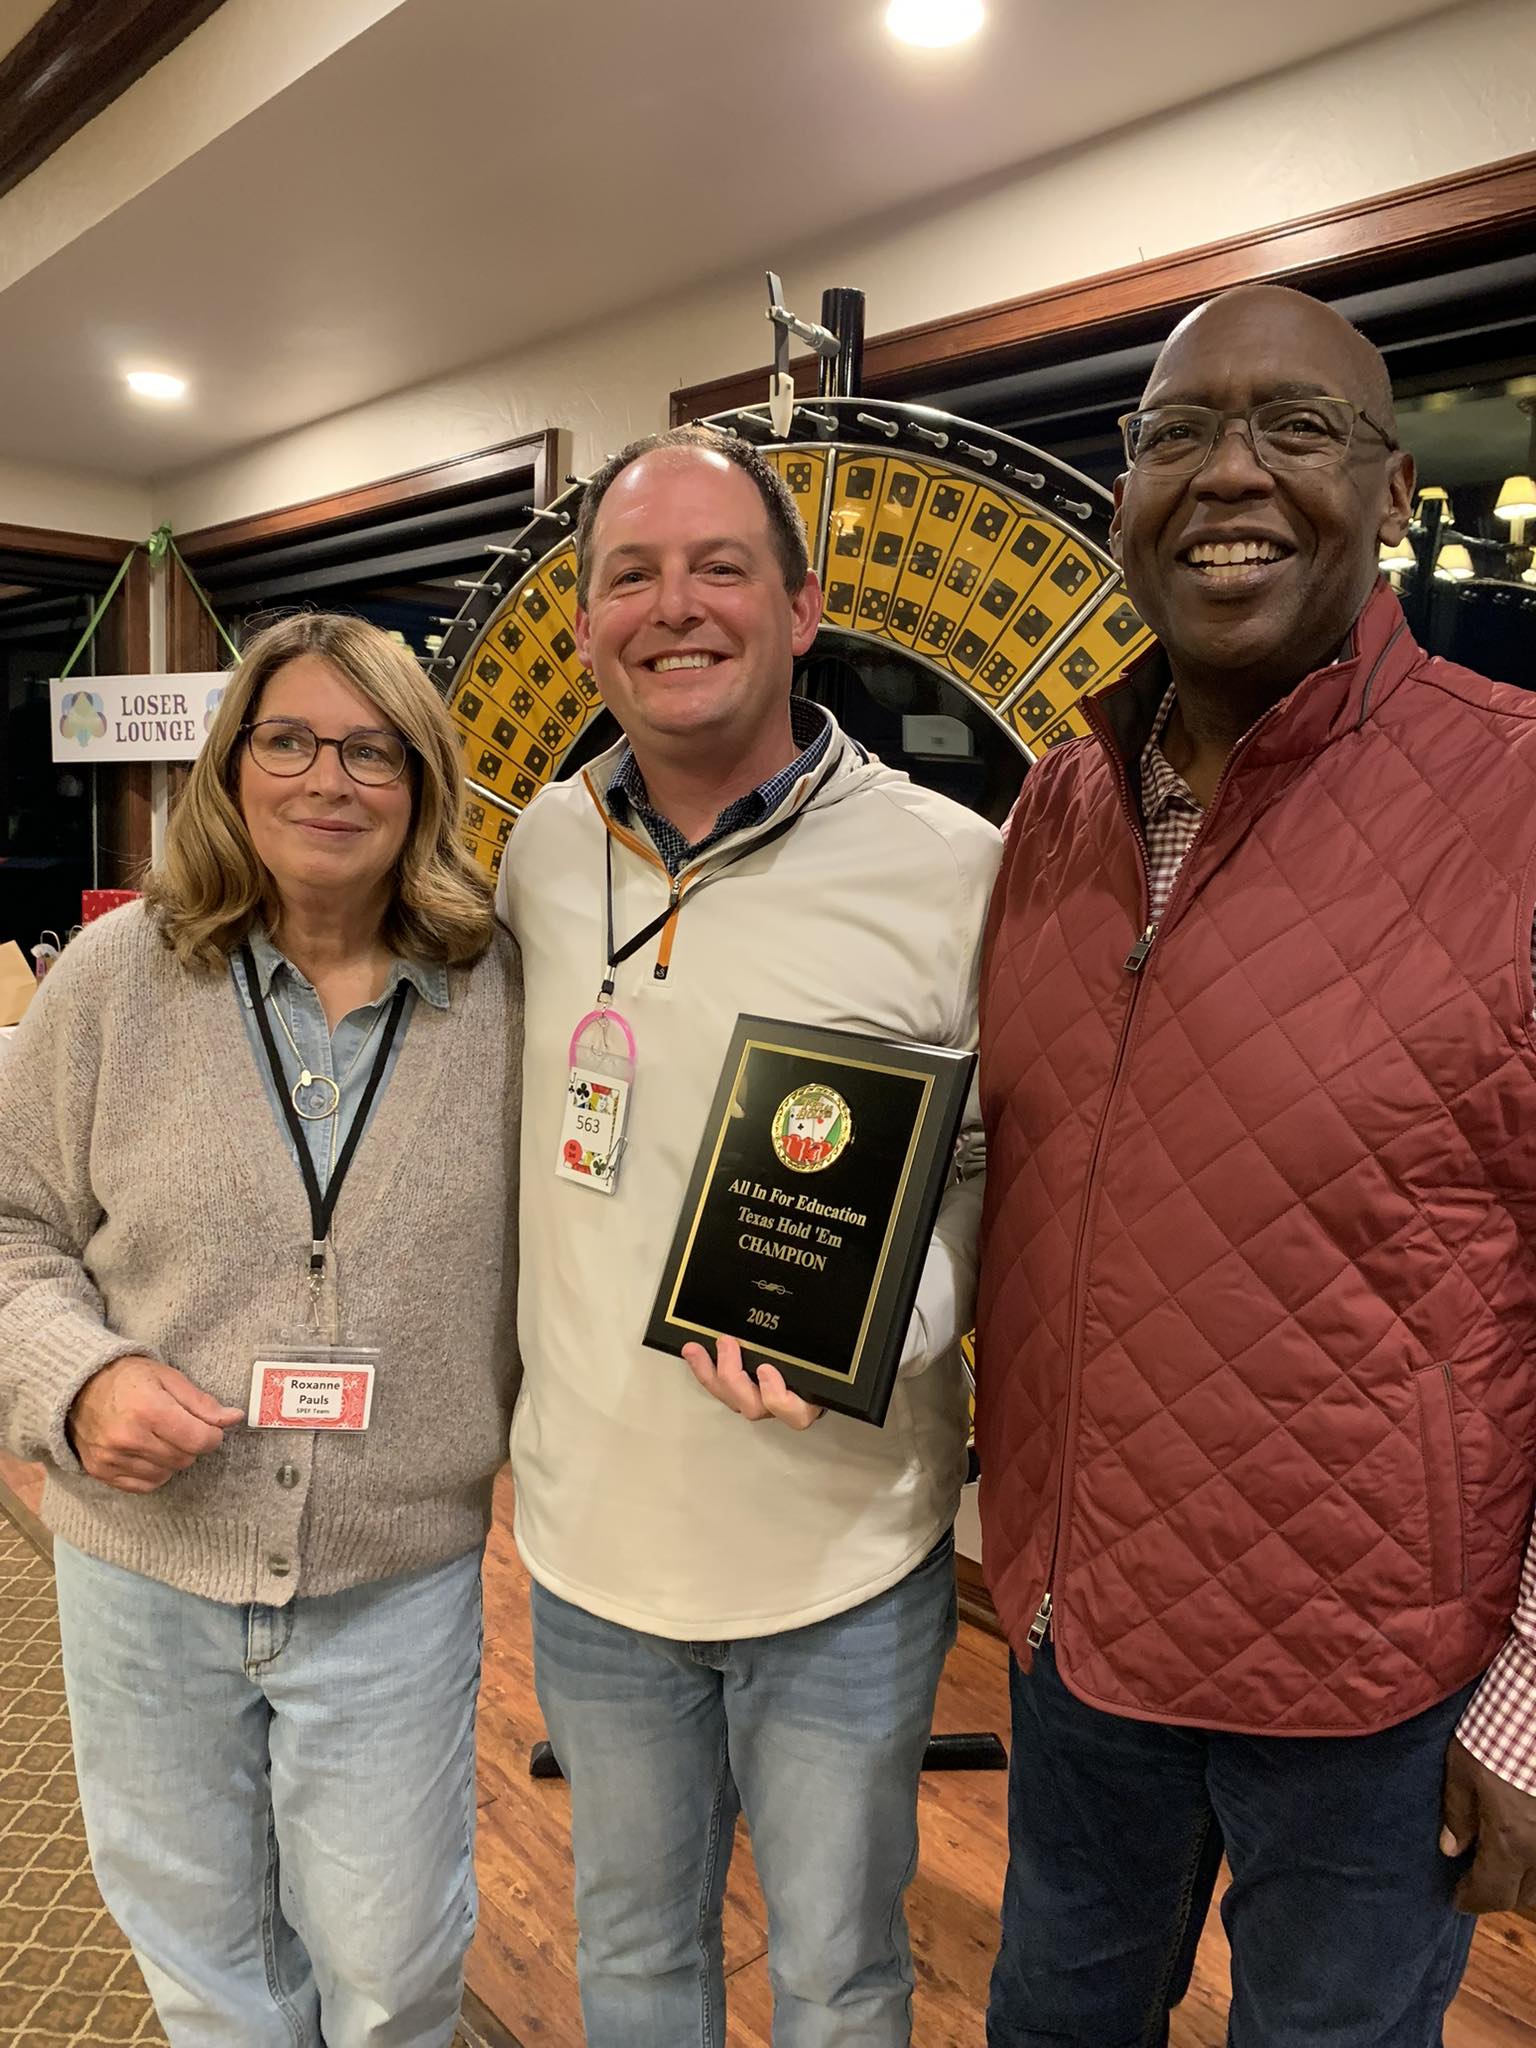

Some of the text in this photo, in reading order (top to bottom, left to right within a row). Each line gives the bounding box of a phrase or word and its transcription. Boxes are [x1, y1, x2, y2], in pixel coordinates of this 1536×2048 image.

[121, 694, 188, 716] LOSER
[115, 720, 195, 742] LOUNGE
[569, 1072, 577, 1084] J
[576, 1114, 600, 1134] 563
[728, 1178, 867, 1227] All In For Education
[737, 1206, 843, 1248] Texas Hold 'Em
[738, 1233, 827, 1272] CHAMPION
[746, 1307, 780, 1330] 2025
[291, 1379, 340, 1390] Roxanne
[299, 1395, 329, 1405] Pauls
